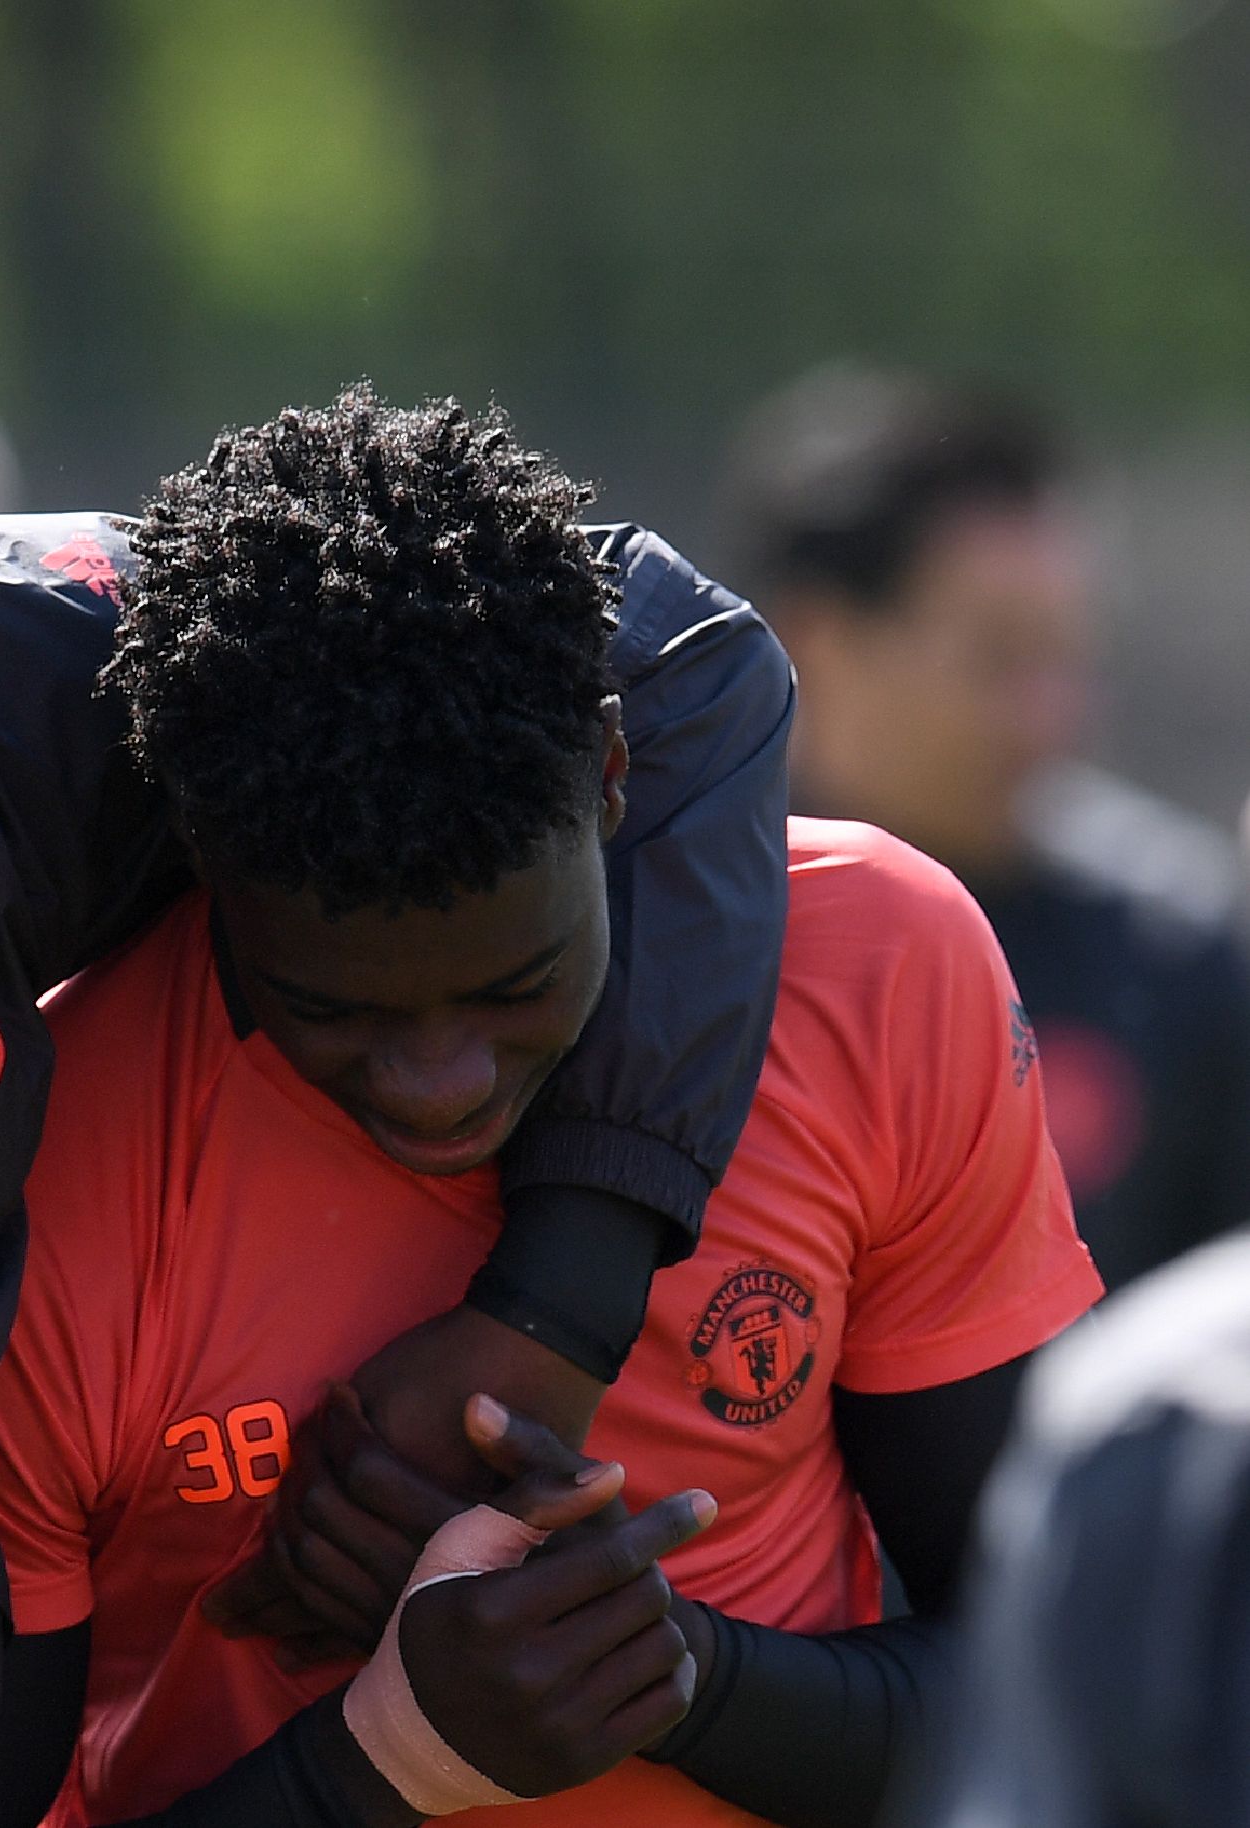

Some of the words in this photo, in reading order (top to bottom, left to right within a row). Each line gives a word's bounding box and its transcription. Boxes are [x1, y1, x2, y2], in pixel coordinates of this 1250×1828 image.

[697, 1273, 807, 1346] MANCHESTER
[725, 1380, 801, 1422] UNITED
[163, 1398, 291, 1504] 38
